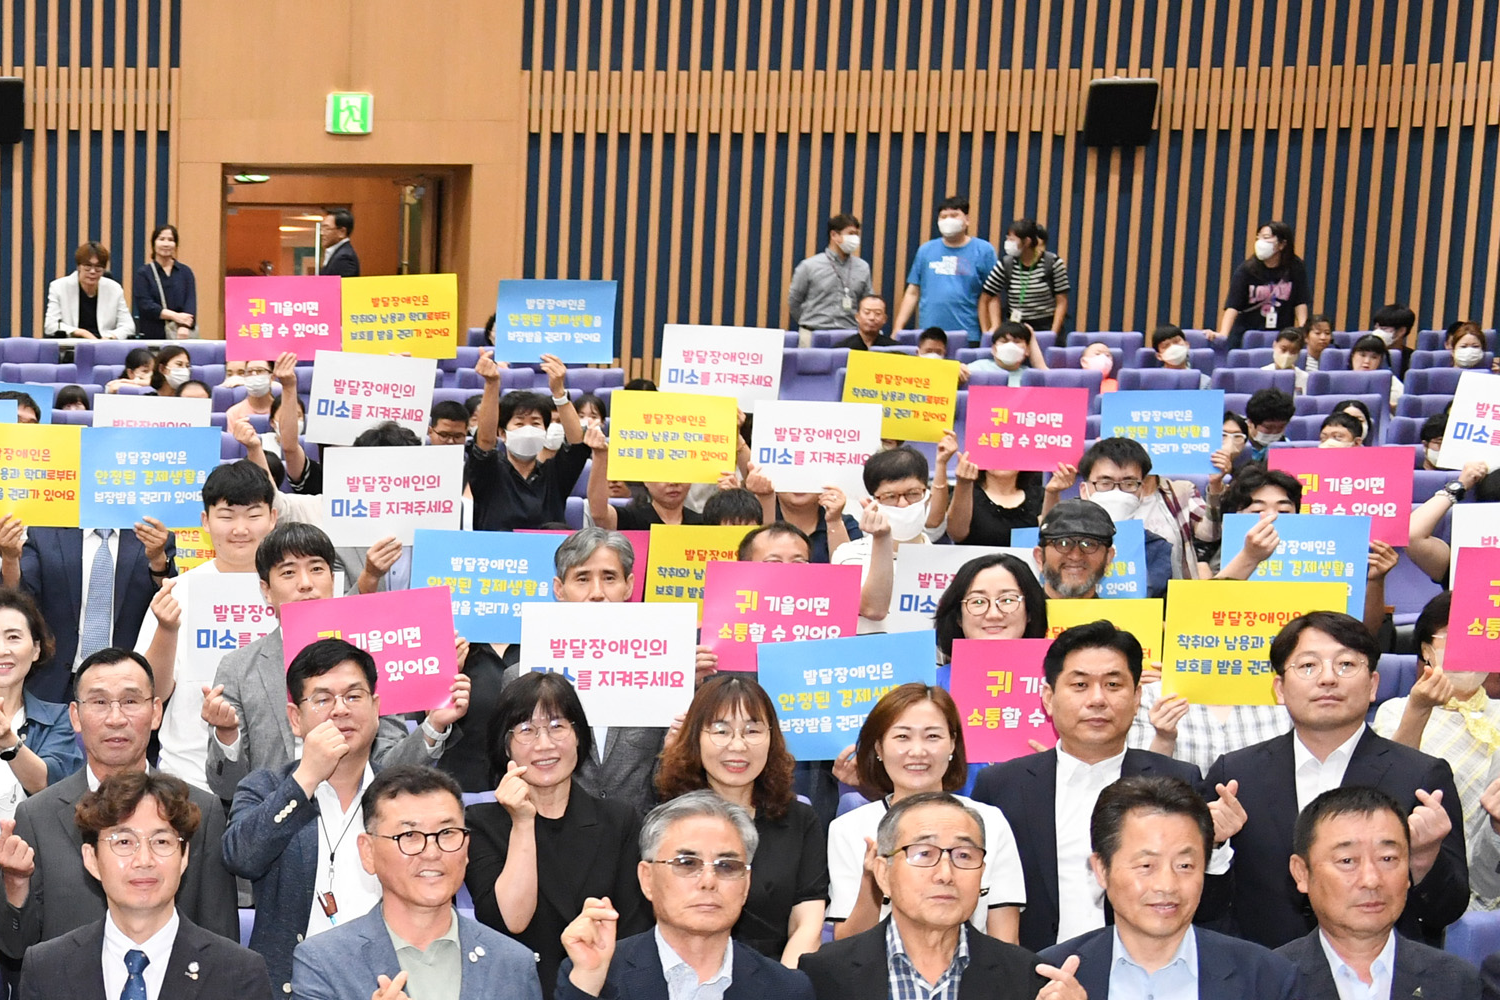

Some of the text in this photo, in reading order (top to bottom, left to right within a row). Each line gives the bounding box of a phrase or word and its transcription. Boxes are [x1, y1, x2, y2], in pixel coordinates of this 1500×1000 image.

[249, 298, 318, 317] 귀 기울이면
[526, 297, 585, 310] 발달장애인은
[508, 314, 601, 327] 안정된 경제생활을
[239, 323, 329, 338] 소통할 수 있어요
[508, 331, 542, 343] 보장받을
[683, 350, 763, 366] 발달장애인의
[668, 368, 773, 387] 미소를 지켜주세요
[334, 379, 415, 398] 발달장애인의
[317, 399, 423, 423] 미소를 지켜주세요
[991, 408, 1063, 428] 귀 기울이면
[643, 414, 706, 427] 발달장애인은
[775, 428, 860, 443] 발달장애인의
[978, 433, 1072, 448] 소통할 수 있어요
[115, 451, 187, 465] 발달장애인은
[647, 448, 665, 460] 받을
[759, 448, 804, 465] 미소를
[24, 468, 76, 481] 학대로부터
[95, 469, 206, 485] 안정된 경제생활을
[347, 475, 440, 492] 발달장애인의
[1324, 477, 1385, 495] 기울이면
[8, 487, 40, 501] 권리가
[43, 489, 75, 501] 있어요
[95, 491, 171, 504] 보장받을 권리가
[332, 499, 453, 518] 미소를 지켜주세요
[735, 590, 830, 616] 귀 기울이면
[718, 623, 786, 642] 소통할 수
[550, 639, 667, 659] 발달장애인의
[1178, 634, 1265, 651] 착취와 남용과
[385, 657, 440, 682] 있어요
[803, 663, 893, 685] 발달장애인은
[1176, 659, 1242, 675] 보호를 받을
[598, 671, 684, 689] 지켜주세요
[986, 671, 1013, 697] 귀
[778, 691, 830, 711] 안정된
[968, 707, 1045, 729] 소통할 수
